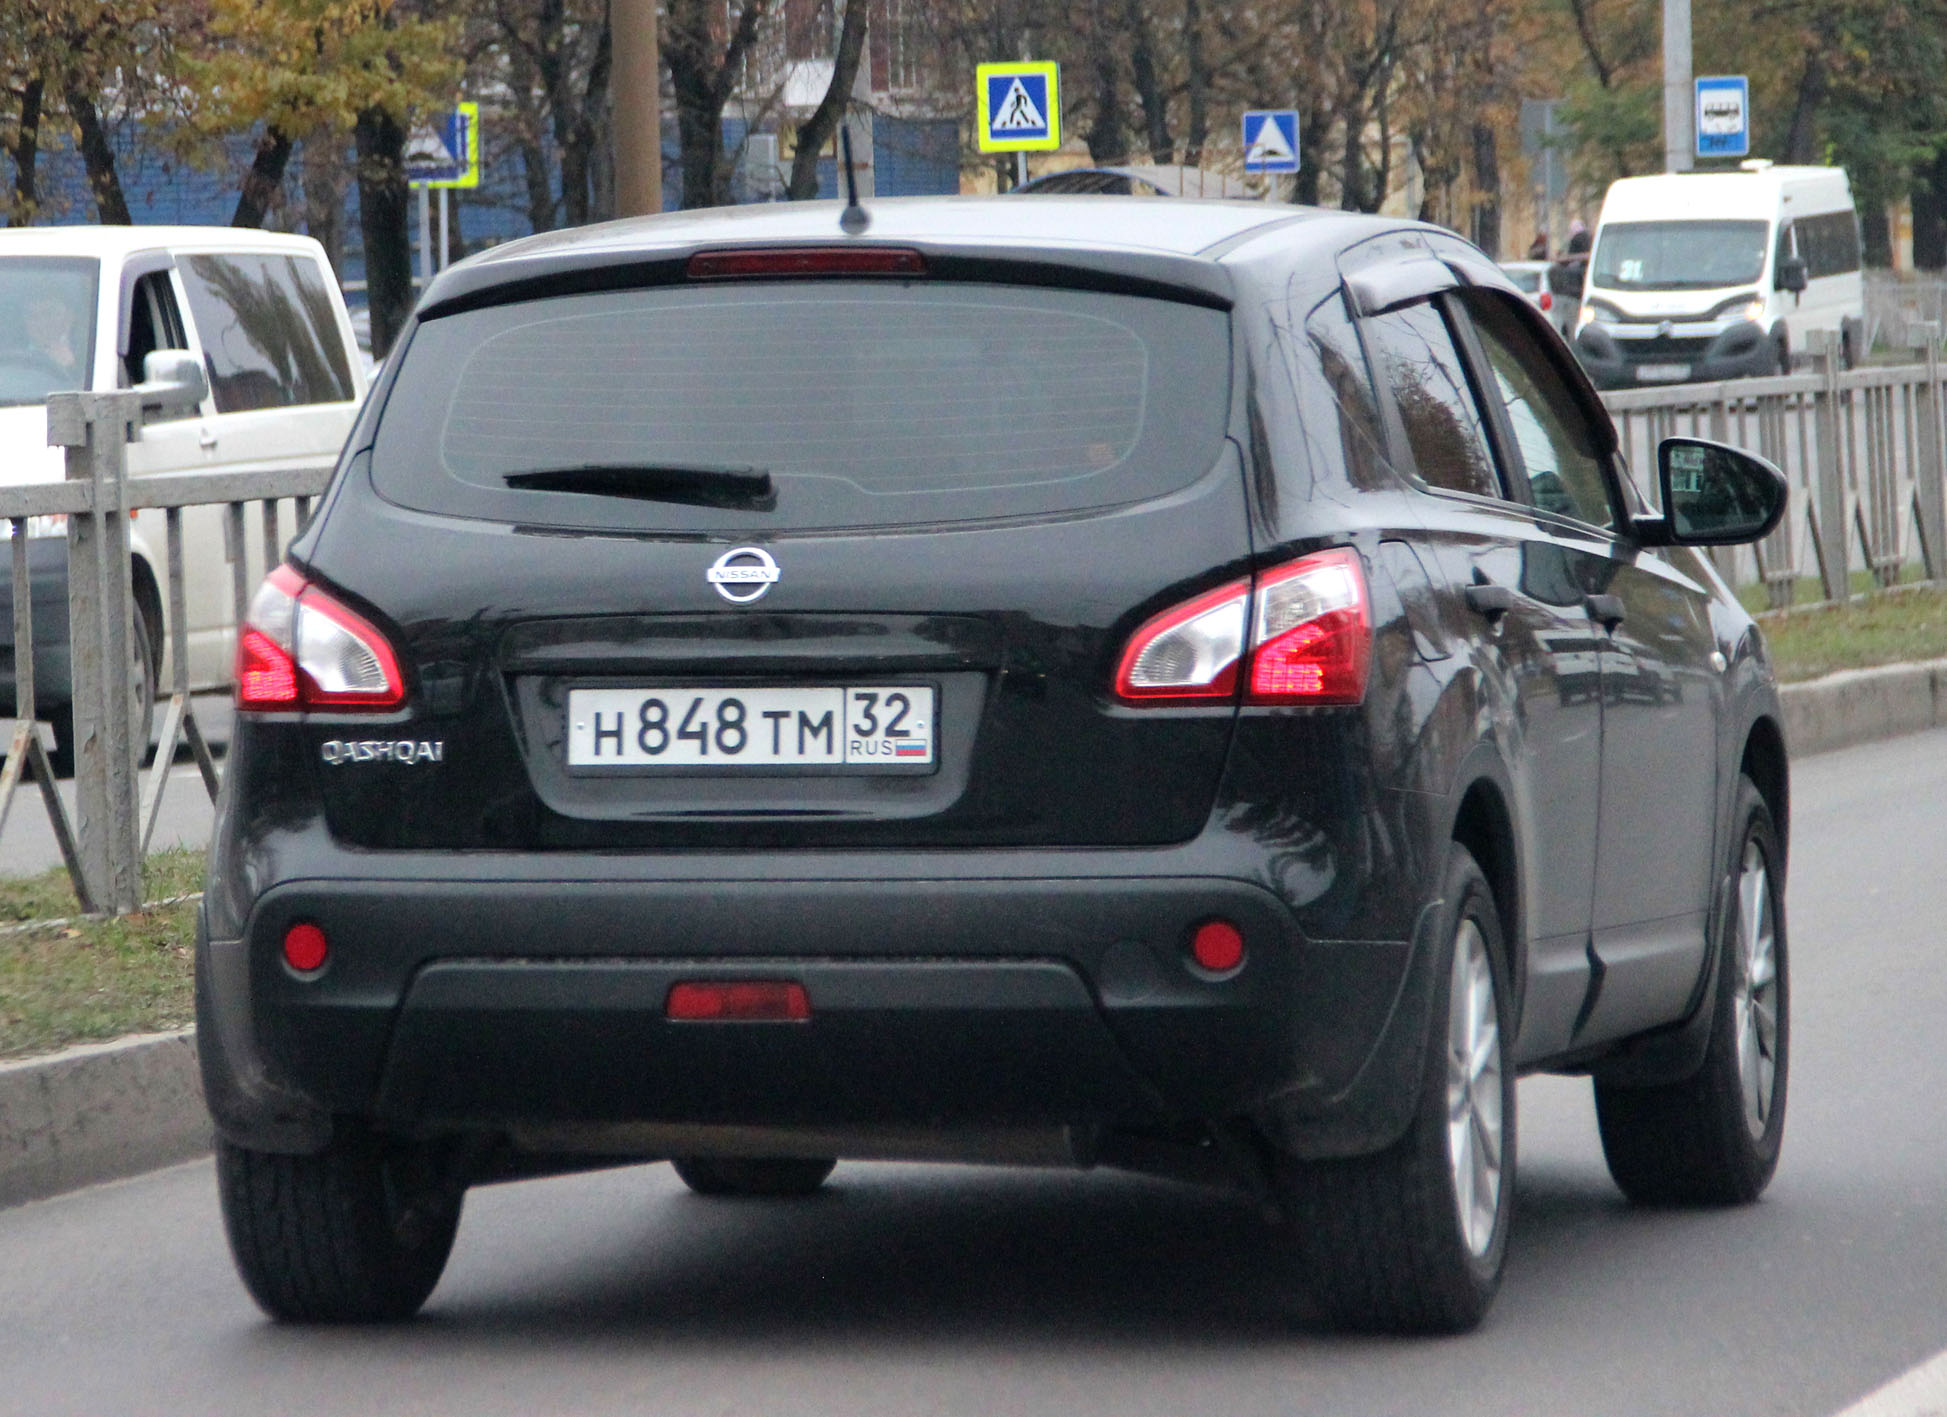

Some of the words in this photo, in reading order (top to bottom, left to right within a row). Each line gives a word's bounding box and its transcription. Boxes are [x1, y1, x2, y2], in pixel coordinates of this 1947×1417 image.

[715, 570, 771, 579] NISSAN
[853, 693, 911, 738] 32
[321, 740, 444, 765] QASHQAI
[850, 740, 892, 755] RUS
